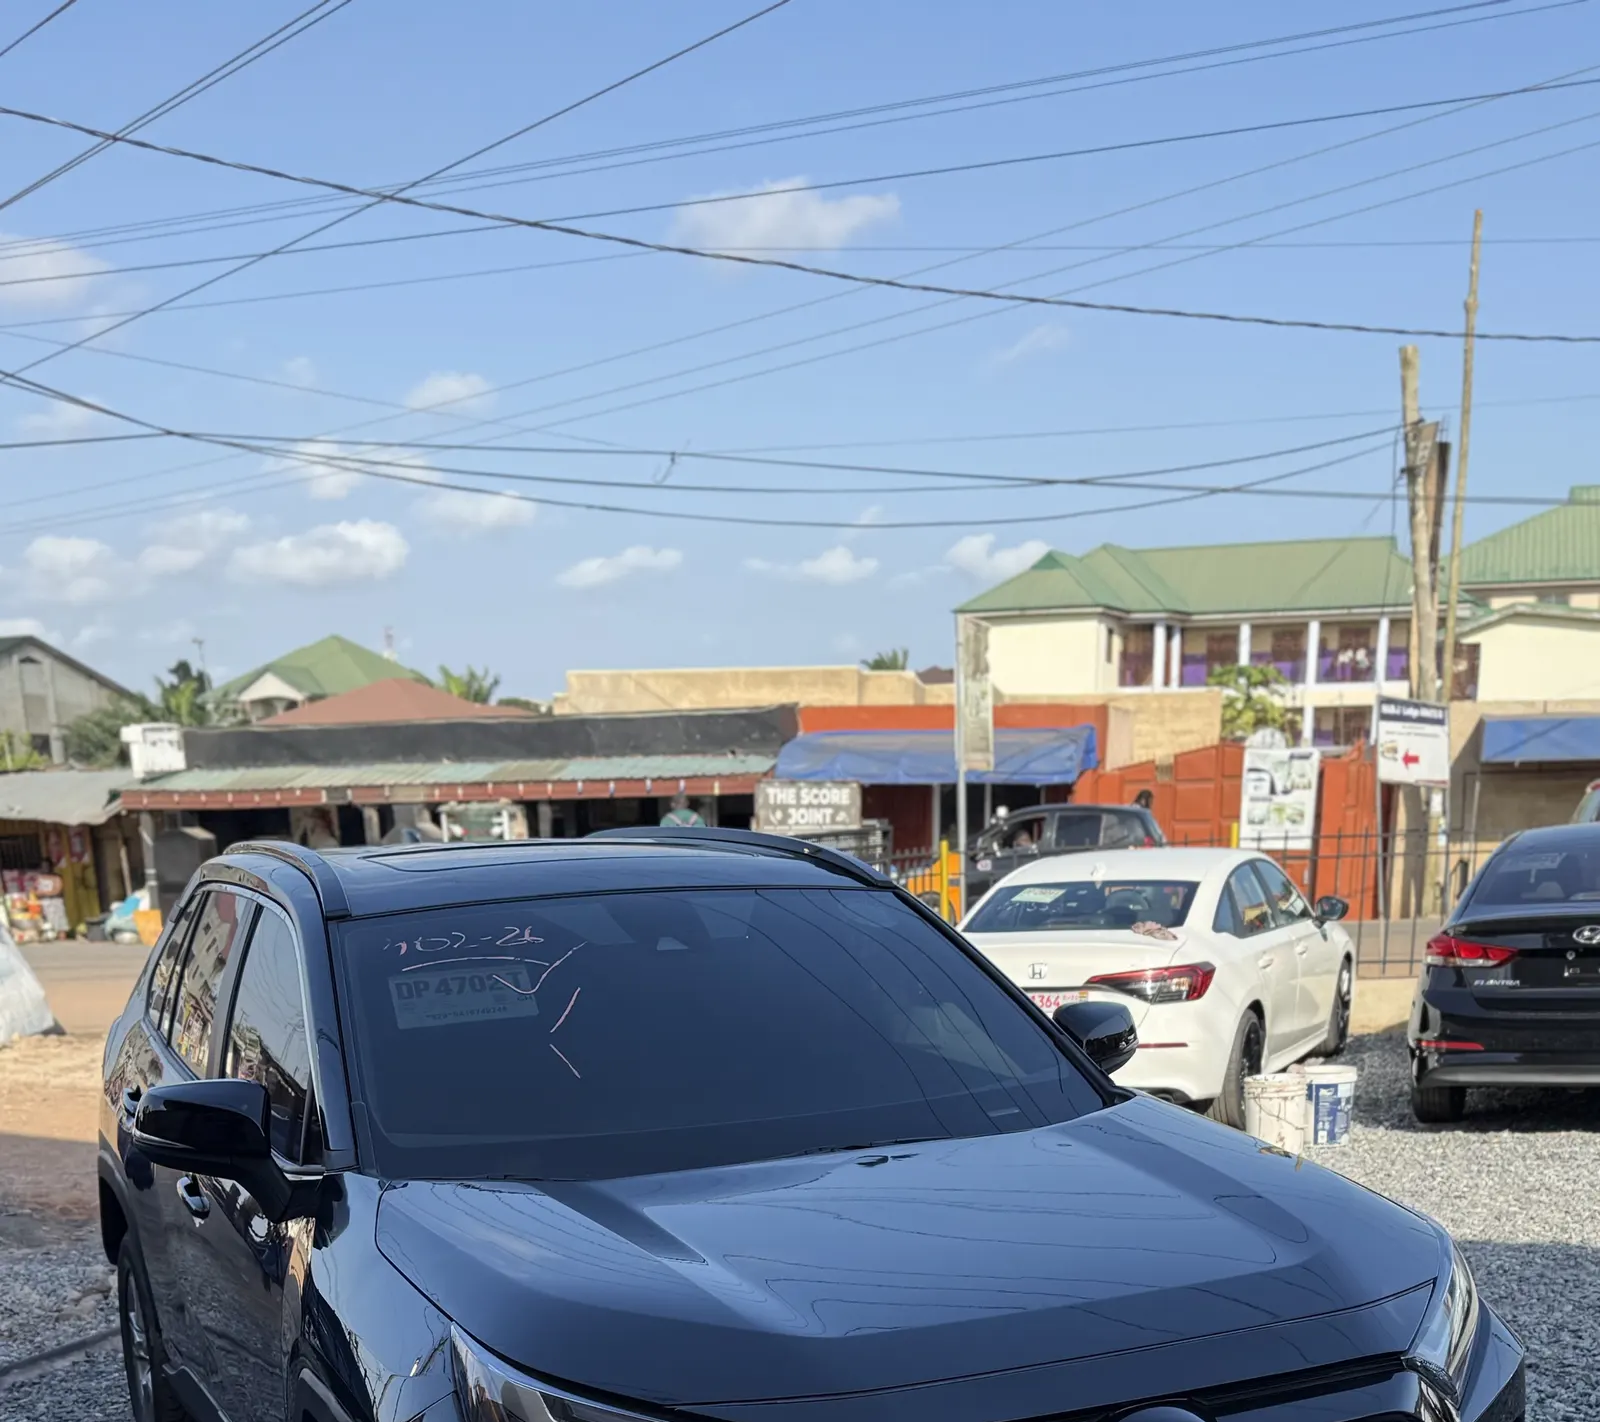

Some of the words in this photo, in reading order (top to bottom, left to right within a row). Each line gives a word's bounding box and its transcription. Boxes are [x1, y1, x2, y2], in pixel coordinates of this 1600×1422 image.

[765, 787, 797, 805] THE
[800, 787, 851, 805] SCORE
[787, 807, 834, 825] JOINT
[394, 981, 429, 1001] DP
